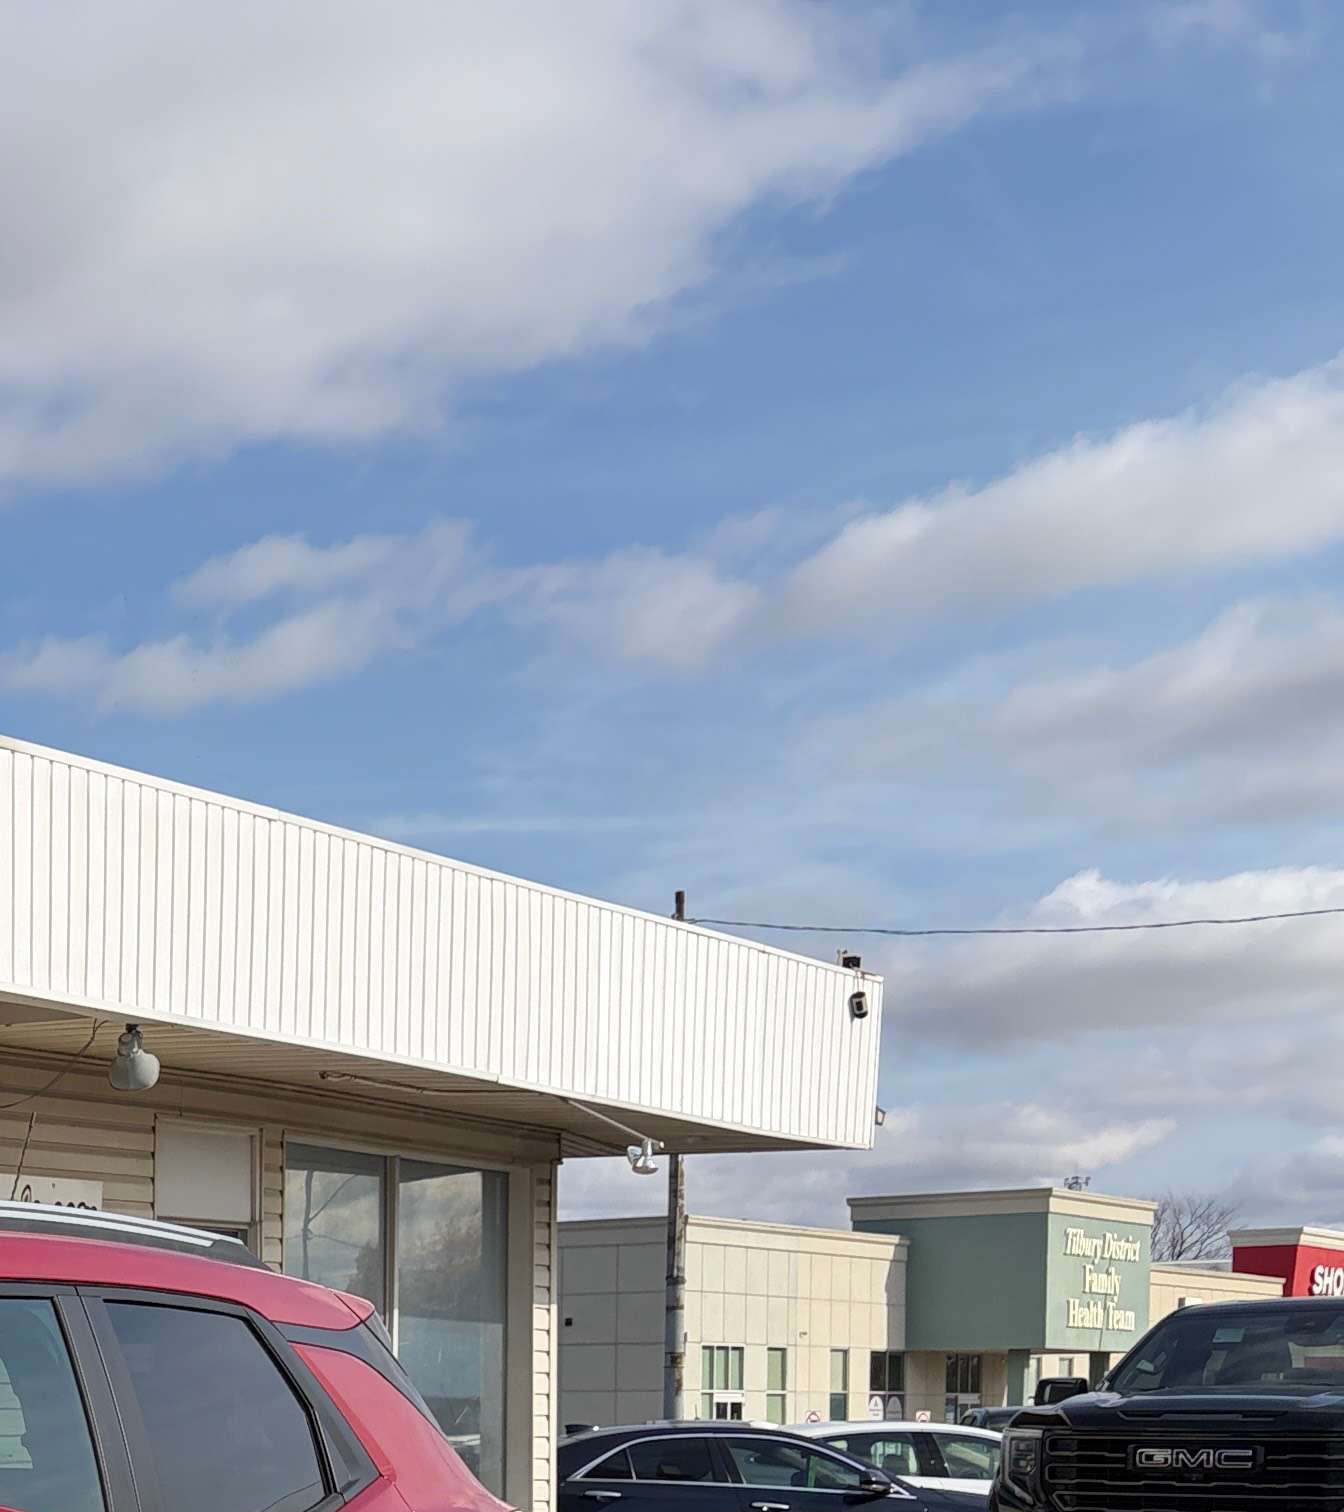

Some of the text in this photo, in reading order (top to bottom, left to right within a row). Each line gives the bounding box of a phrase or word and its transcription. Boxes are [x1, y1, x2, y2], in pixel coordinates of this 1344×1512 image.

[1065, 1227, 1141, 1264] Tilbury District
[1084, 1264, 1122, 1303] Family
[1067, 1298, 1136, 1331] Health Team
[1135, 1448, 1253, 1468] GMC
